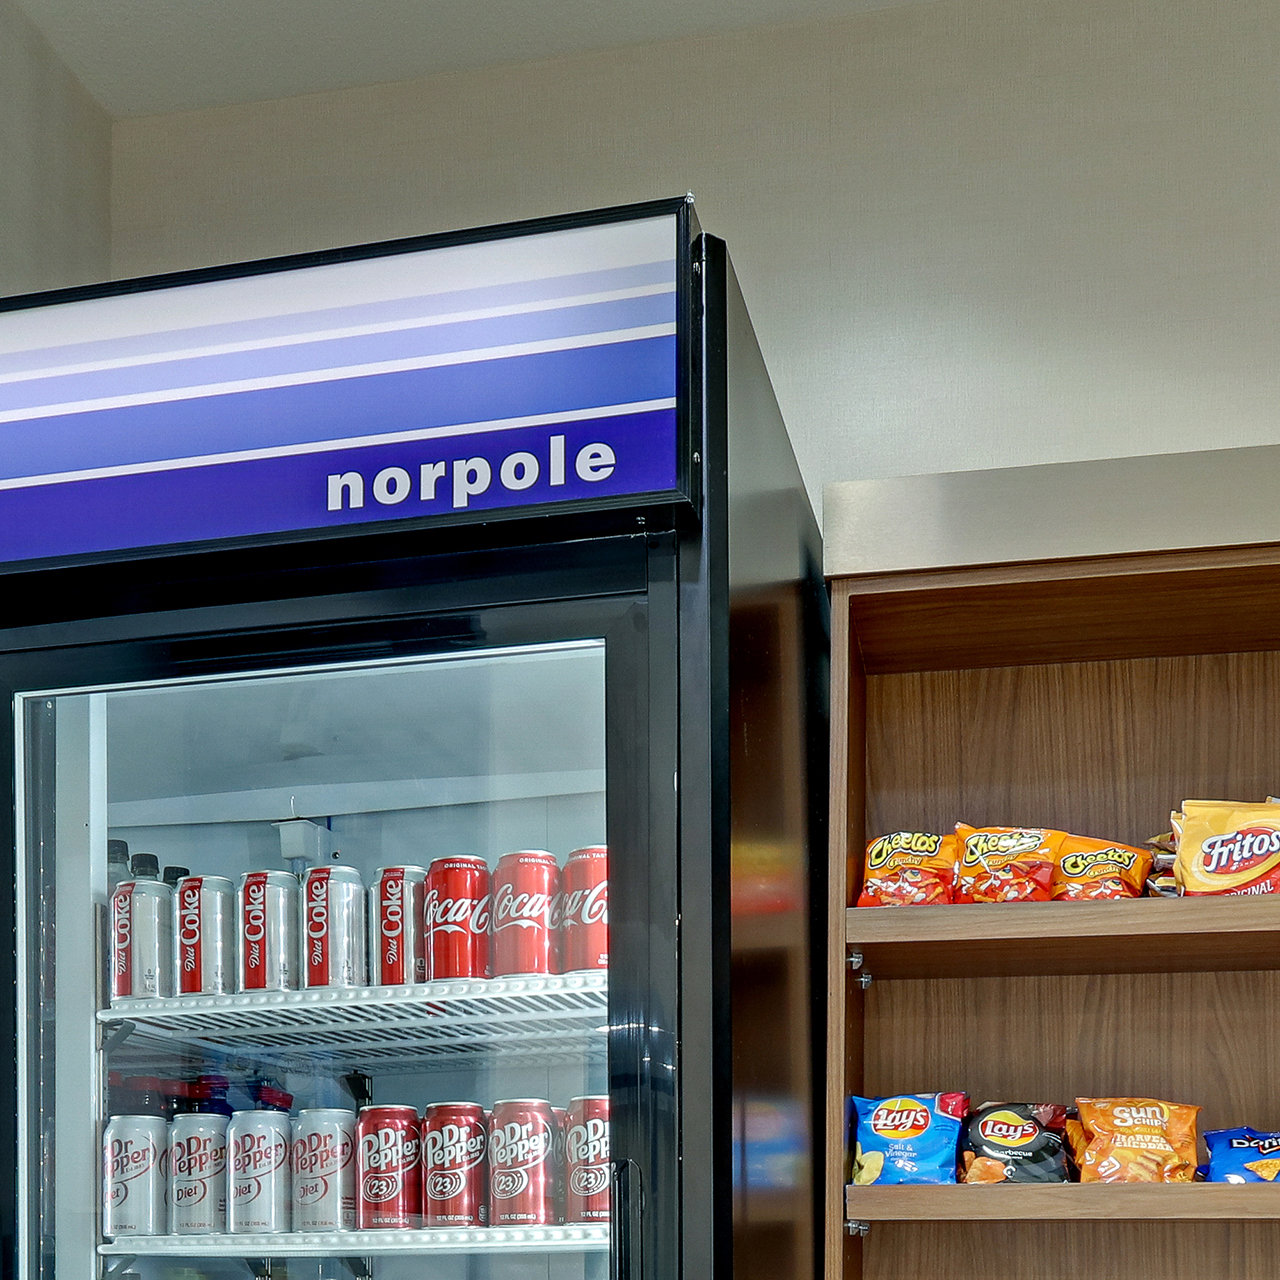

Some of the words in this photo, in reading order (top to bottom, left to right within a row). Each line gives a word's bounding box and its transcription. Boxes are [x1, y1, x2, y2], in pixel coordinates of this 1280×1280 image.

[327, 434, 616, 511] norpole
[868, 832, 940, 868] Cheetos
[887, 856, 922, 869] Crunchy
[1062, 849, 1136, 876] Cheetos
[1087, 864, 1120, 877] Crunchy
[180, 888, 200, 945] Coke
[245, 884, 264, 941] Coke
[308, 881, 327, 938] Coke
[382, 880, 402, 937] Coke
[117, 894, 130, 949] Coke
[879, 1107, 930, 1130] Lay's
[983, 1120, 1035, 1137] Lay's
[240, 1133, 266, 1153] Dr
[308, 1133, 334, 1153] Dr
[377, 1128, 406, 1151] Dr
[442, 1124, 470, 1147] Dr
[504, 1122, 532, 1144] Dr
[186, 1136, 212, 1155] Dr
[425, 1131, 484, 1170] Pepper
[490, 1130, 548, 1168] Pepper
[885, 1149, 917, 1158] Vinegar
[888, 1143, 904, 1151] Salt
[372, 1179, 386, 1195] 23
[435, 1178, 451, 1192] 23
[499, 1176, 515, 1191] 23
[579, 1173, 595, 1187] 23
[176, 1186, 198, 1201] Diet
